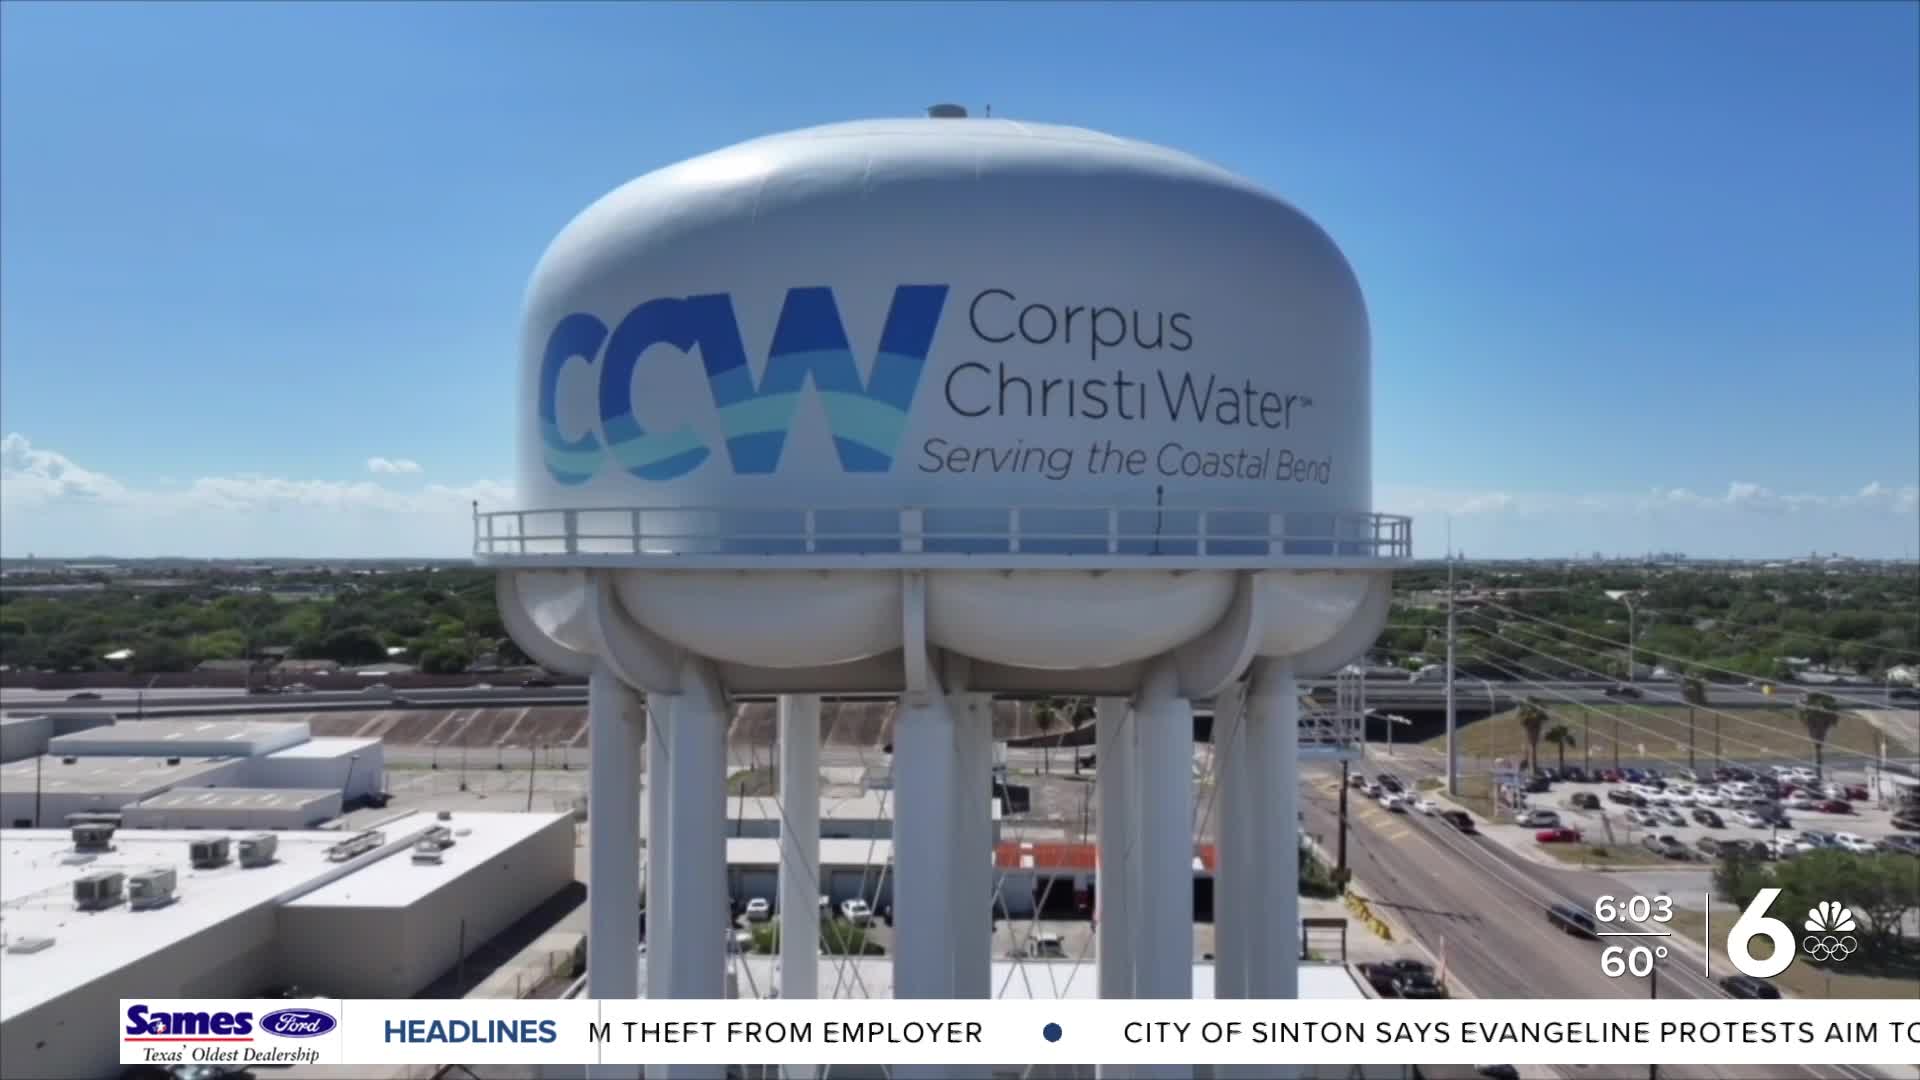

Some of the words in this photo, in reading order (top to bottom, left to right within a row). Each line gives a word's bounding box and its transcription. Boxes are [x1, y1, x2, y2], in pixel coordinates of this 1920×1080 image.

[968, 288, 1194, 361] Corpus
[538, 284, 950, 486] CCW
[944, 361, 1146, 420] Christi
[1157, 369, 1297, 430] Water
[917, 437, 1074, 481] Serving
[1086, 440, 1147, 476] the
[1156, 442, 1270, 479] Coastal
[1276, 448, 1332, 485] Bend
